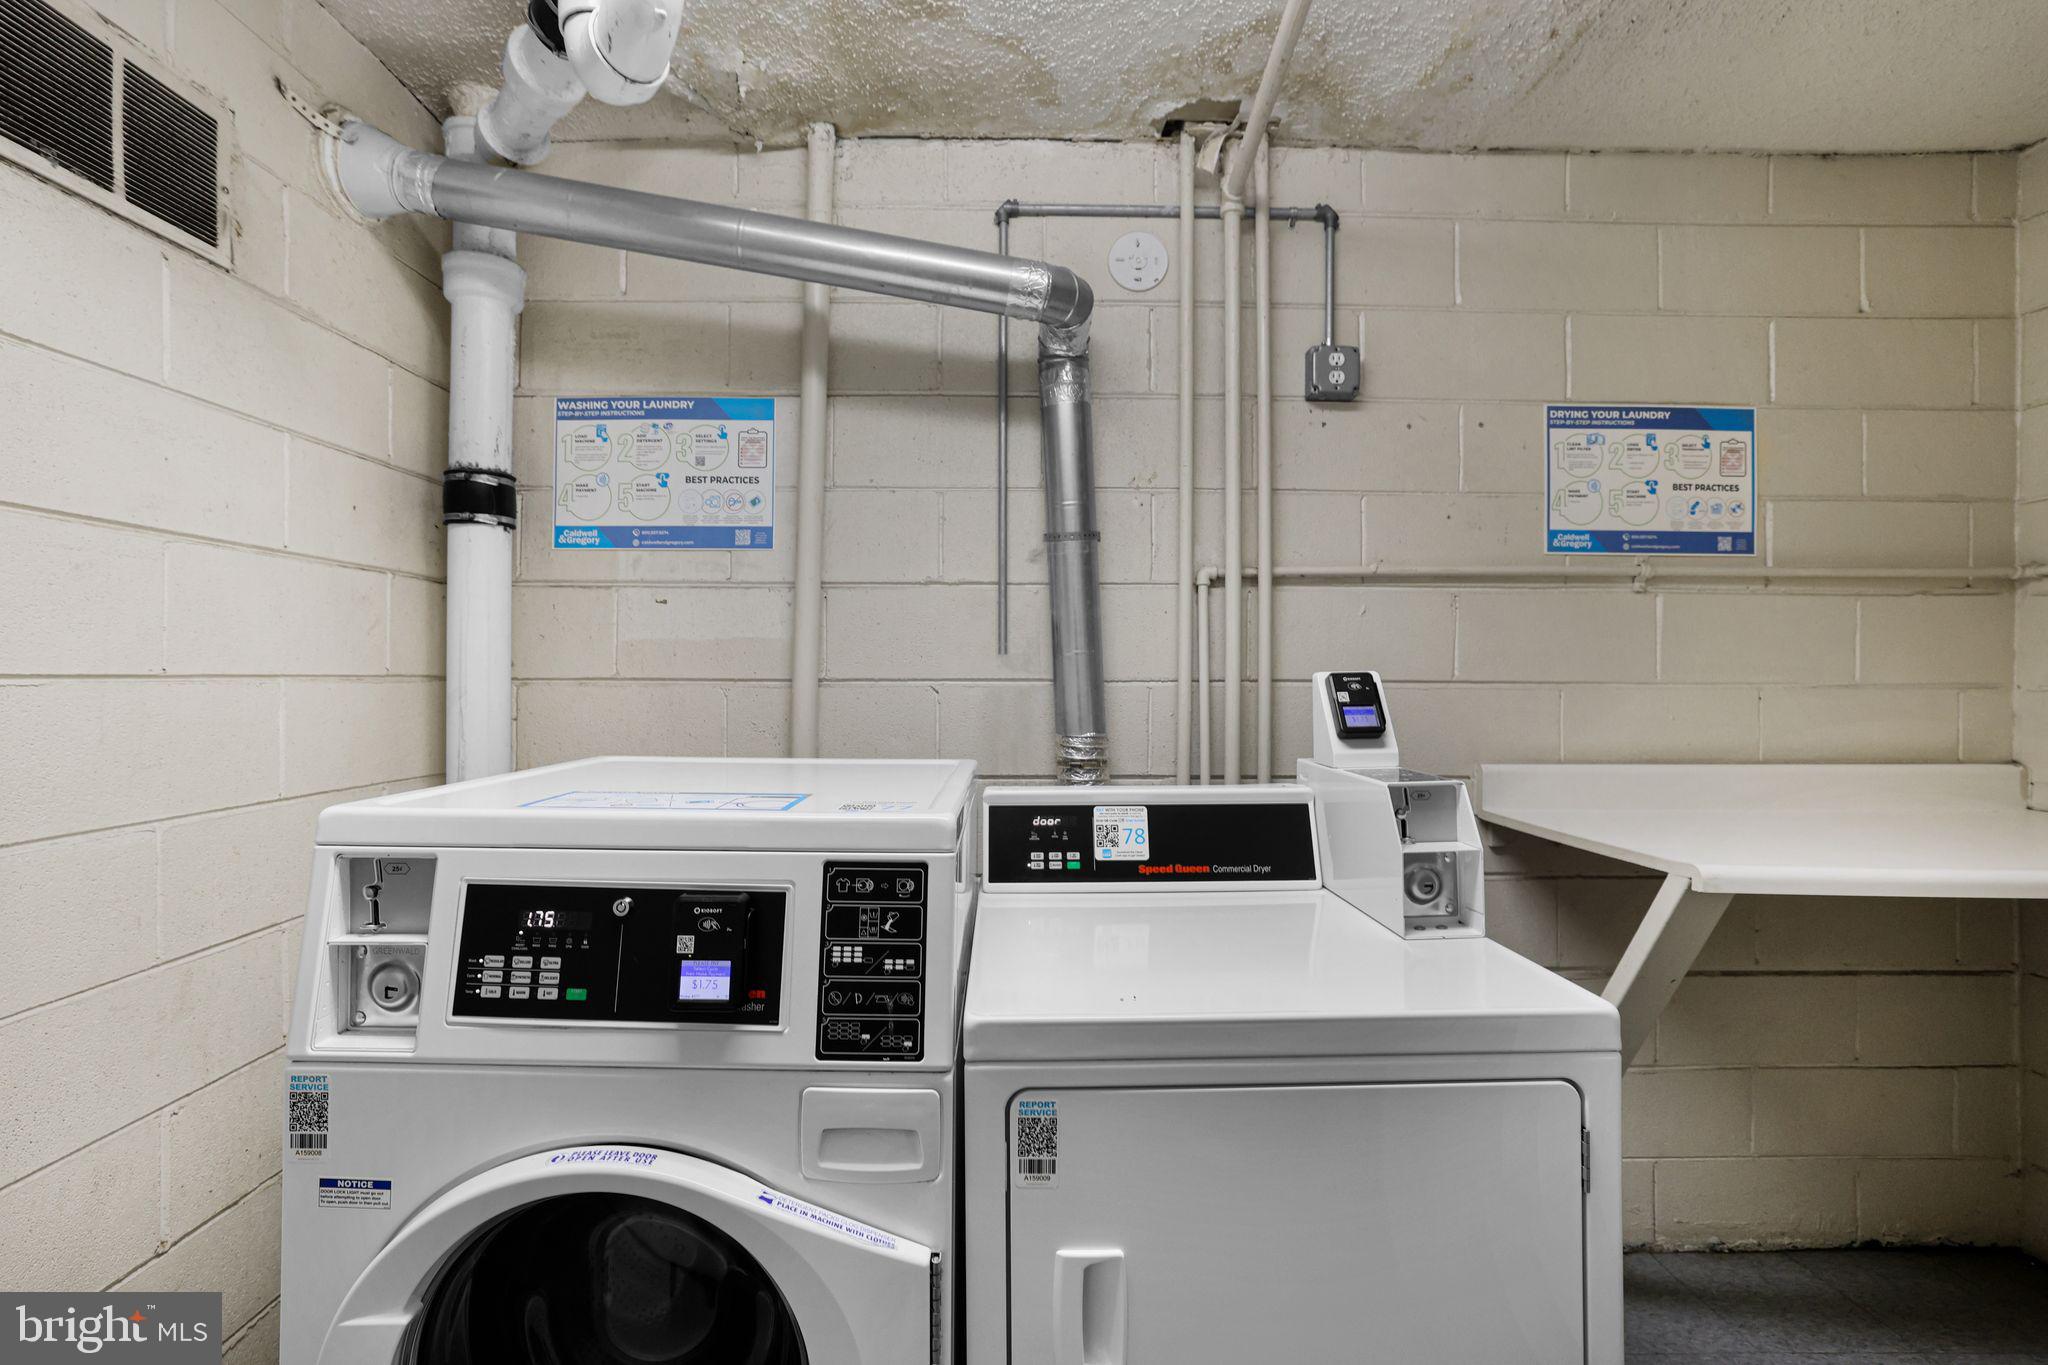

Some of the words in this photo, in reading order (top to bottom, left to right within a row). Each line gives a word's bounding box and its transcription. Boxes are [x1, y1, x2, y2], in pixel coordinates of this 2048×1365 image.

[558, 401, 608, 409] WASHING
[610, 401, 640, 409] YOUR
[643, 401, 695, 409] LAUNDRY
[1550, 410, 1589, 418] DRYING
[1591, 410, 1620, 418] YOUR
[1622, 411, 1671, 419] LAUNDRY
[617, 433, 634, 462] 2
[676, 433, 693, 462] 3
[1609, 442, 1624, 470] 2
[1664, 442, 1679, 470] 3
[686, 476, 708, 484] BEST
[710, 476, 760, 484] PRACTICES
[1695, 484, 1740, 492] PRACTICES
[558, 483, 574, 512] 4
[618, 482, 634, 512] 5
[1552, 489, 1567, 516] 4
[1609, 489, 1624, 517] 5
[1558, 533, 1590, 541] Caldwell
[1032, 816, 1061, 826] door
[1123, 828, 1145, 845] 78
[1138, 864, 1173, 874] Speed
[1175, 864, 1210, 873] Queen
[1212, 865, 1252, 873] Commercial
[1253, 865, 1271, 874] Dryer
[372, 946, 420, 955] GREENWALD
[692, 979, 718, 990] $1.75
[742, 1002, 765, 1012] asher
[291, 1075, 328, 1083] REPORT
[633, 1152, 658, 1160] DOOR
[338, 1180, 374, 1188] NOTICE
[777, 1201, 797, 1213] PLACE
[800, 1209, 808, 1217] IN
[810, 1214, 843, 1230] MACHINE
[845, 1226, 864, 1238] WITH
[866, 1234, 895, 1249] CLOTHES
